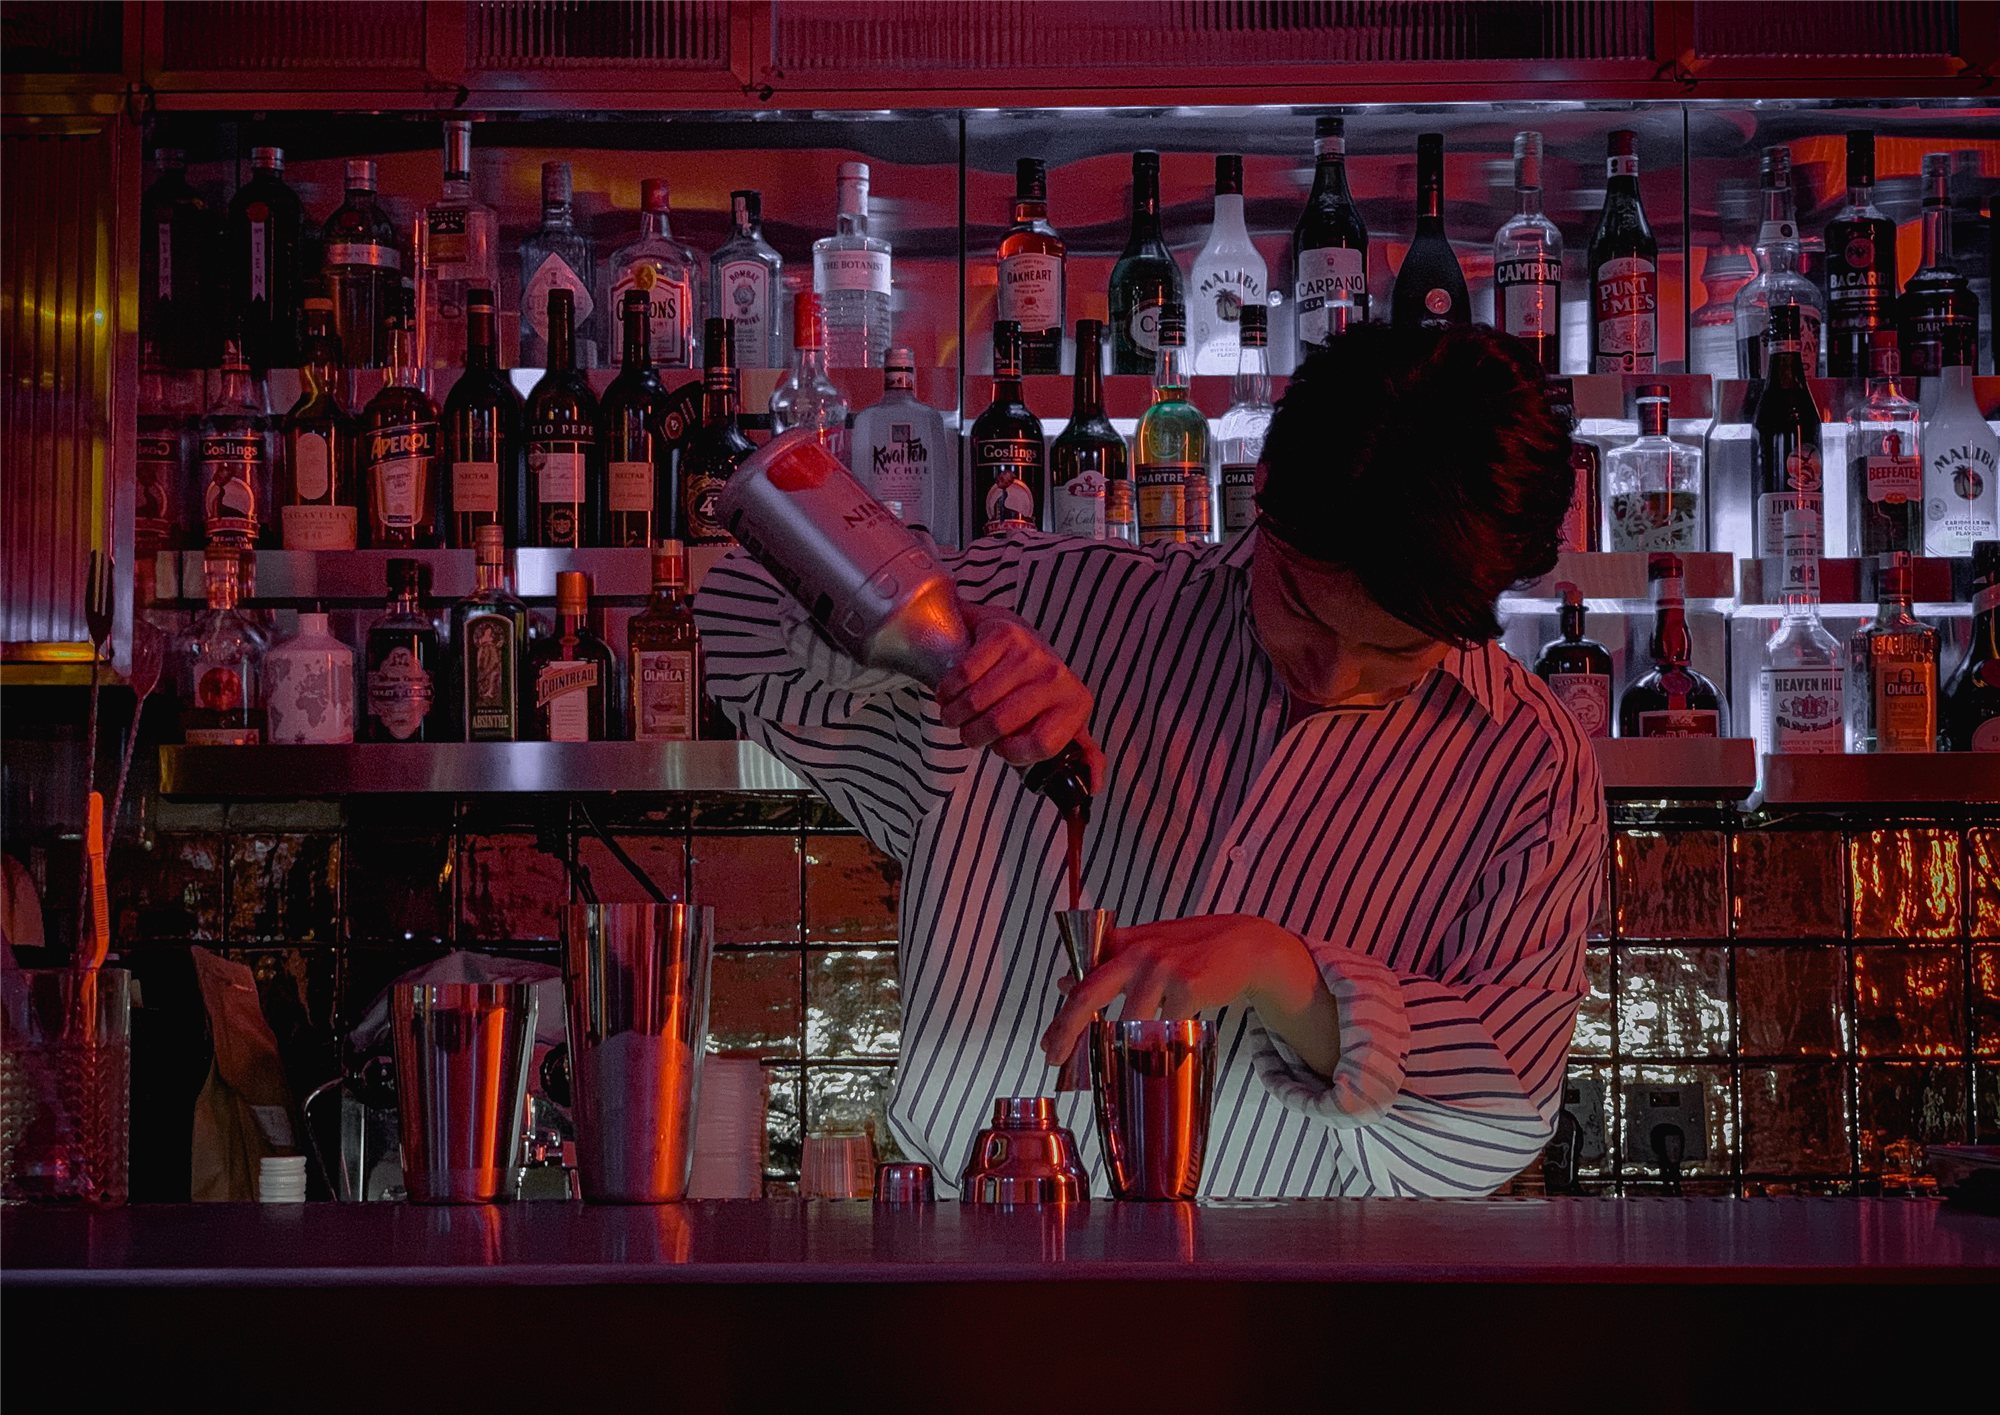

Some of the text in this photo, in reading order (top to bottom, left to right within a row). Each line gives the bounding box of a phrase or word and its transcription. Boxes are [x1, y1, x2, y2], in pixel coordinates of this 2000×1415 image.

[823, 260, 884, 272] THE BOTANIST
[1497, 262, 1561, 283] CAMPARI
[1007, 269, 1052, 284] OAKHEART
[1200, 270, 1260, 297] MALIBU
[1299, 275, 1363, 297] CARPANO
[1600, 277, 1648, 300] PUNT
[1611, 293, 1656, 314] MES
[531, 424, 595, 436] TIO PEPE
[203, 442, 258, 460] Goslings
[371, 432, 431, 460] APEROL
[984, 444, 1037, 463] Goslings
[1934, 445, 1996, 474] MALIBU
[458, 472, 490, 480] NECTAR
[541, 667, 594, 699] COINTREAU
[643, 669, 684, 682] OLMECA
[1775, 678, 1819, 692] HEAVEN
[1886, 683, 1926, 695] OLMECA
[472, 714, 510, 729] ABSINTHE
